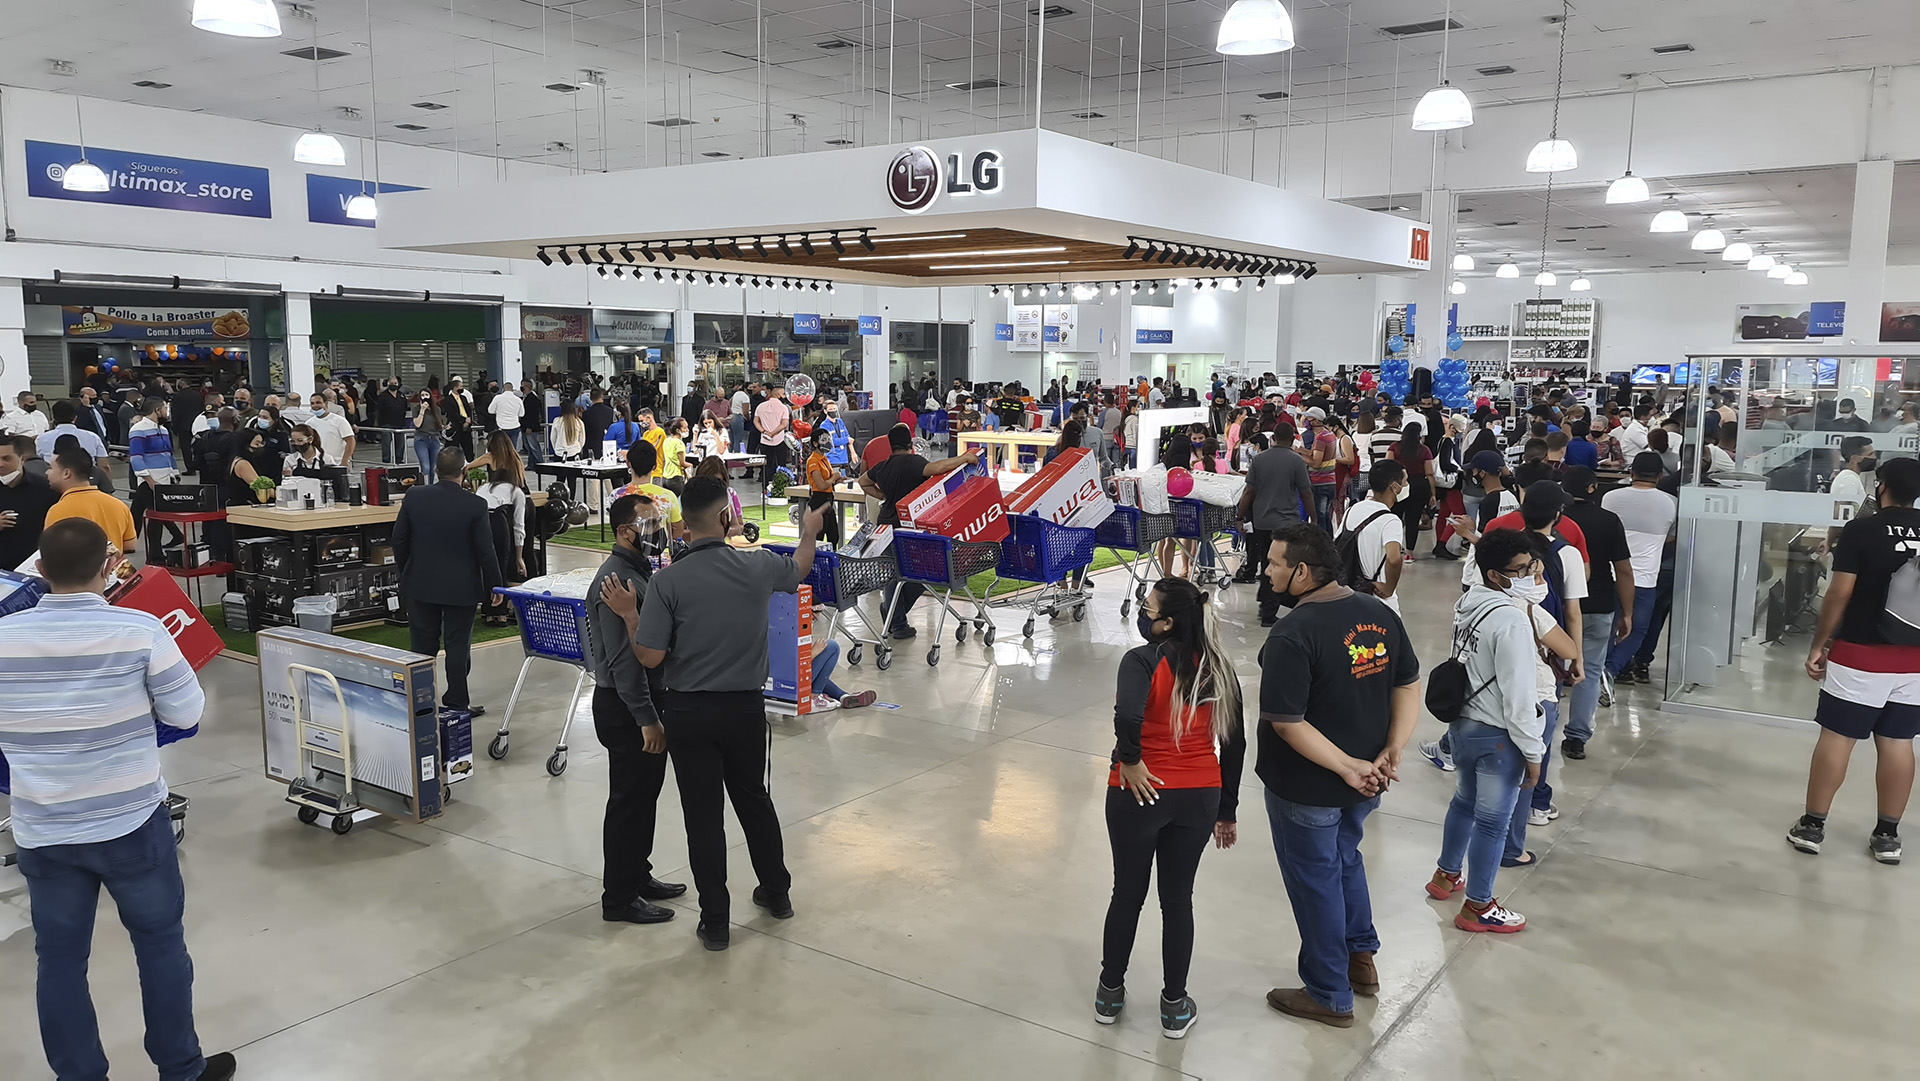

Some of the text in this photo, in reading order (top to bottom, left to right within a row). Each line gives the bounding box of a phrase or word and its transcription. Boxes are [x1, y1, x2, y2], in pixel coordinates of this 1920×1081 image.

[131, 161, 178, 175] Síguenos
[946, 151, 999, 194] LG
[108, 307, 216, 322] Pollo a la Broaster
[613, 319, 652, 331] MultiMax
[796, 320, 810, 328] CAJA
[147, 327, 212, 337] Come lo bueno...
[581, 469, 599, 477] Galaxy
[162, 493, 194, 502] NESPRESSO
[914, 488, 942, 514] aiwa
[1052, 478, 1097, 525] iwa
[1343, 623, 1387, 648] Mini Market
[262, 641, 293, 656] SAMSUNG
[421, 804, 434, 816] 50
